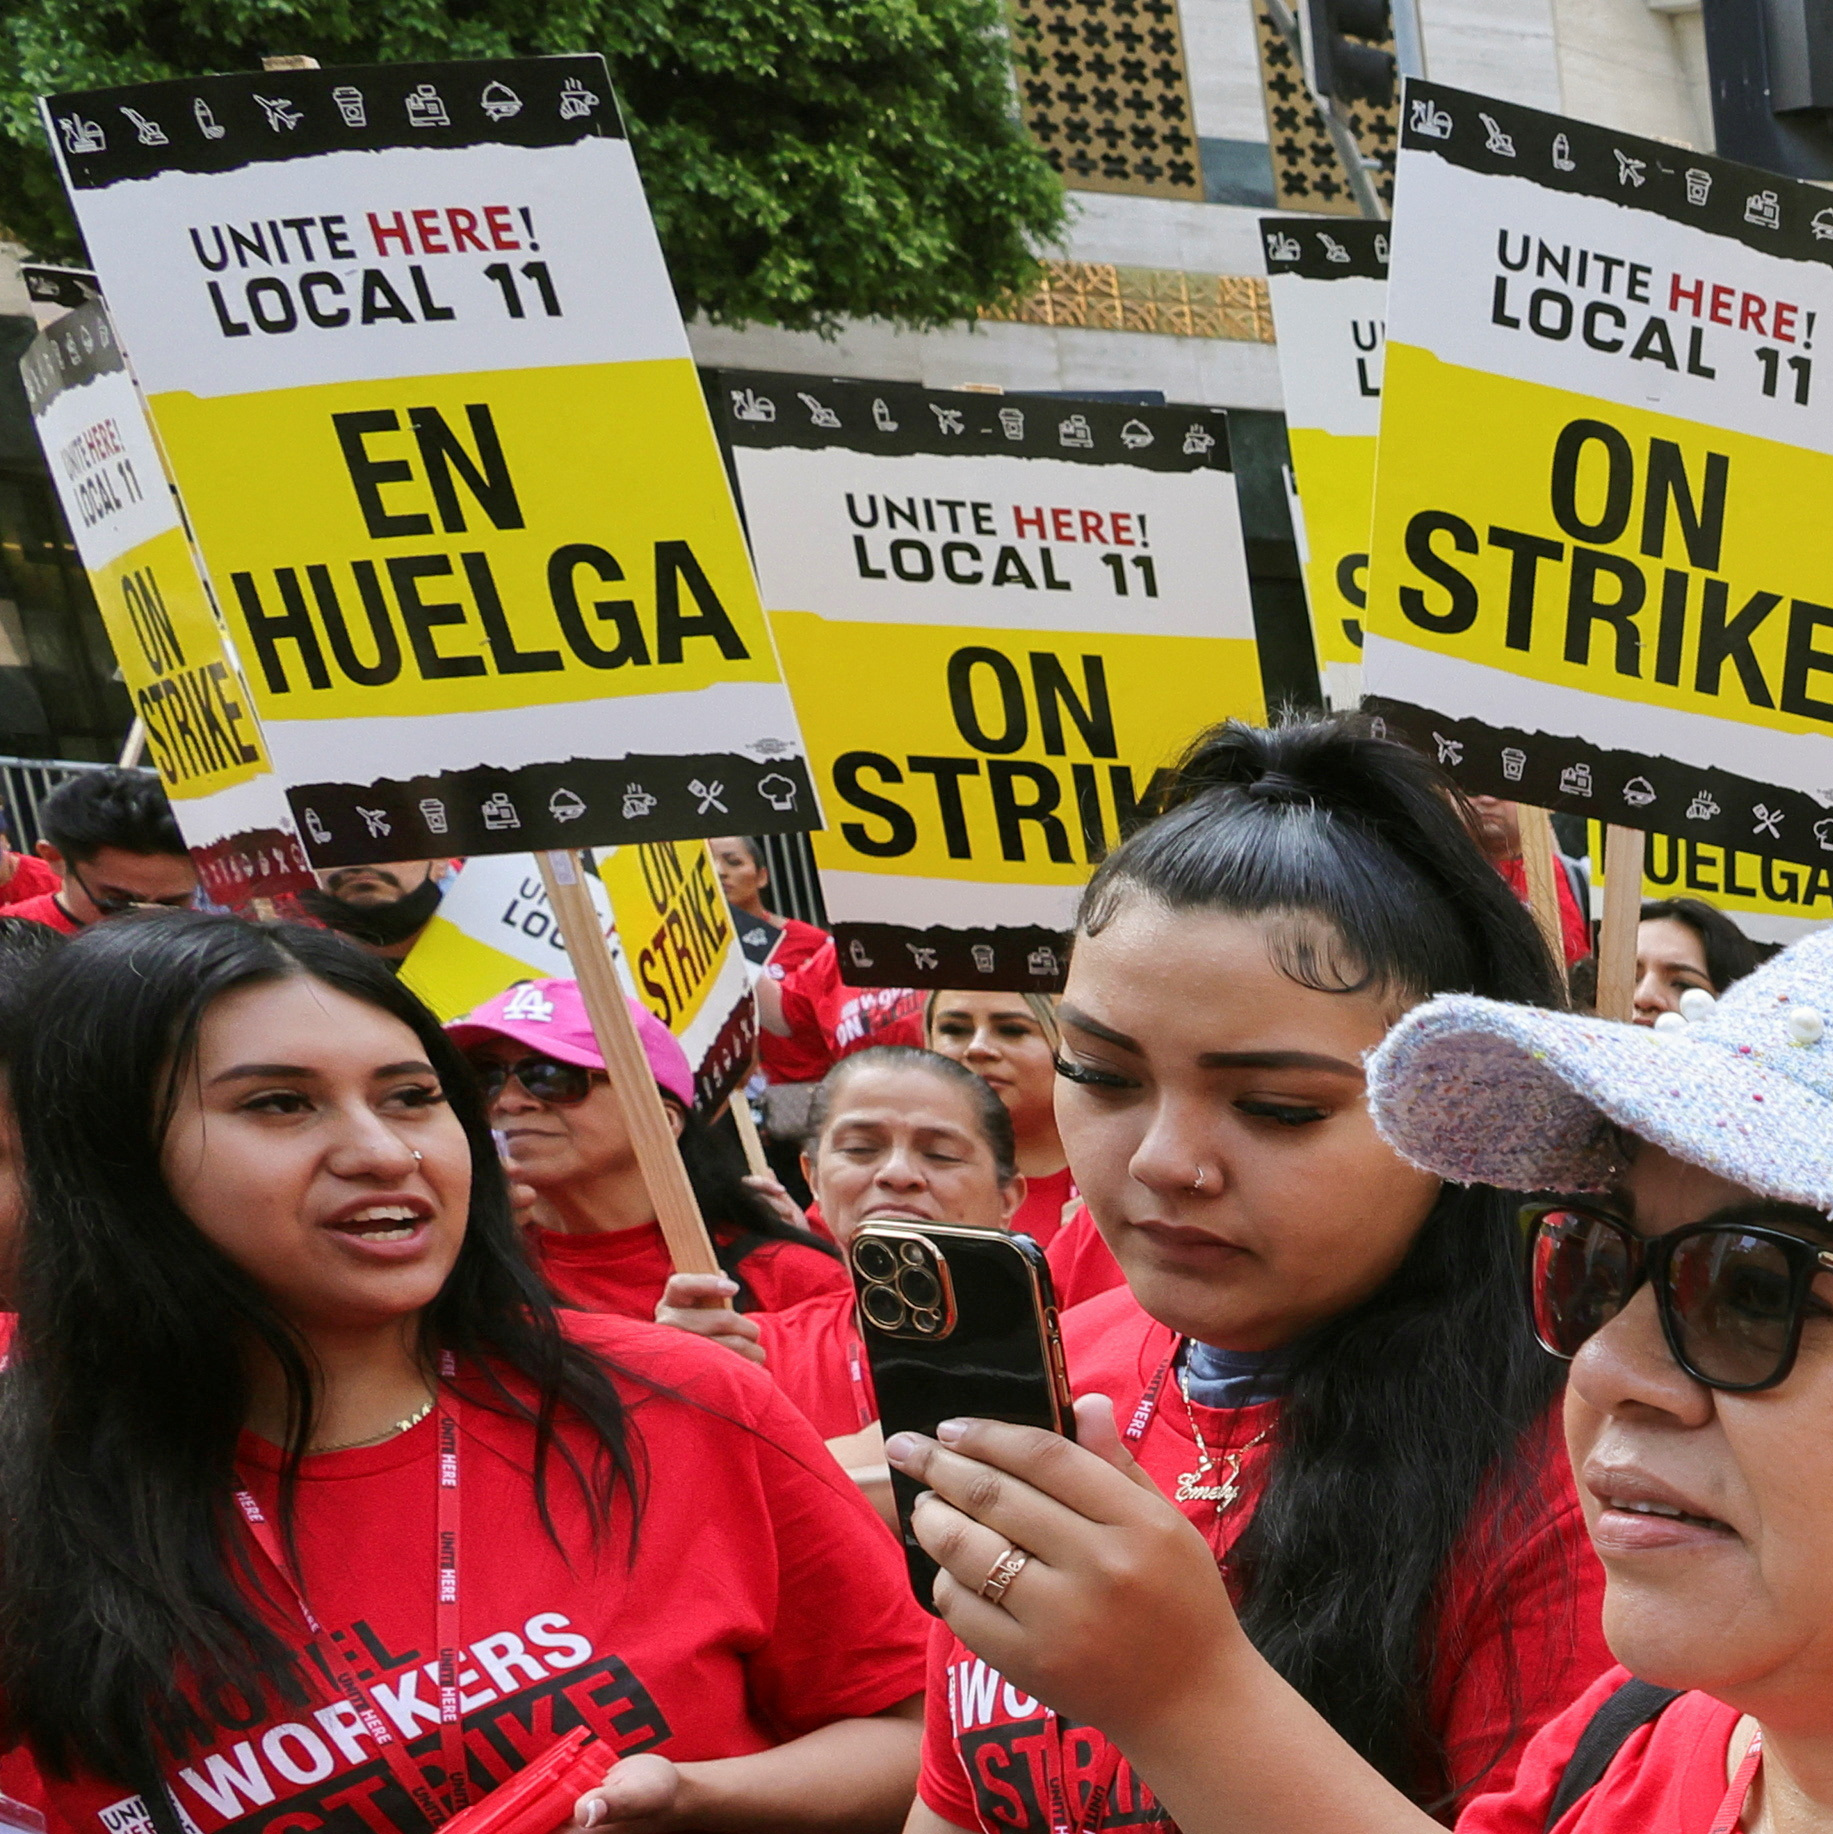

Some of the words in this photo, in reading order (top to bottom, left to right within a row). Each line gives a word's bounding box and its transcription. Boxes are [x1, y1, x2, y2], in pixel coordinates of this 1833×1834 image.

[190, 214, 357, 272] UNITE
[367, 206, 542, 258] HERE!
[1496, 227, 1653, 306] UNITE
[1668, 272, 1817, 351] HERE!
[208, 264, 456, 337] LOCAL
[485, 262, 563, 320] 11
[1491, 274, 1717, 381] LOCAL
[1755, 345, 1813, 407] 11
[73, 467, 122, 528] LOCAL
[117, 458, 142, 503] 11
[331, 402, 526, 539] EN
[846, 492, 997, 537] UNITE
[1012, 504, 1150, 547] HERE!
[1550, 417, 1731, 574] ON
[120, 565, 189, 677] ON
[230, 539, 750, 695] HUELGA
[852, 534, 1071, 591] LOCAL
[1102, 552, 1159, 598] 11
[136, 660, 260, 787] STRIKE
[947, 646, 1118, 759] ON
